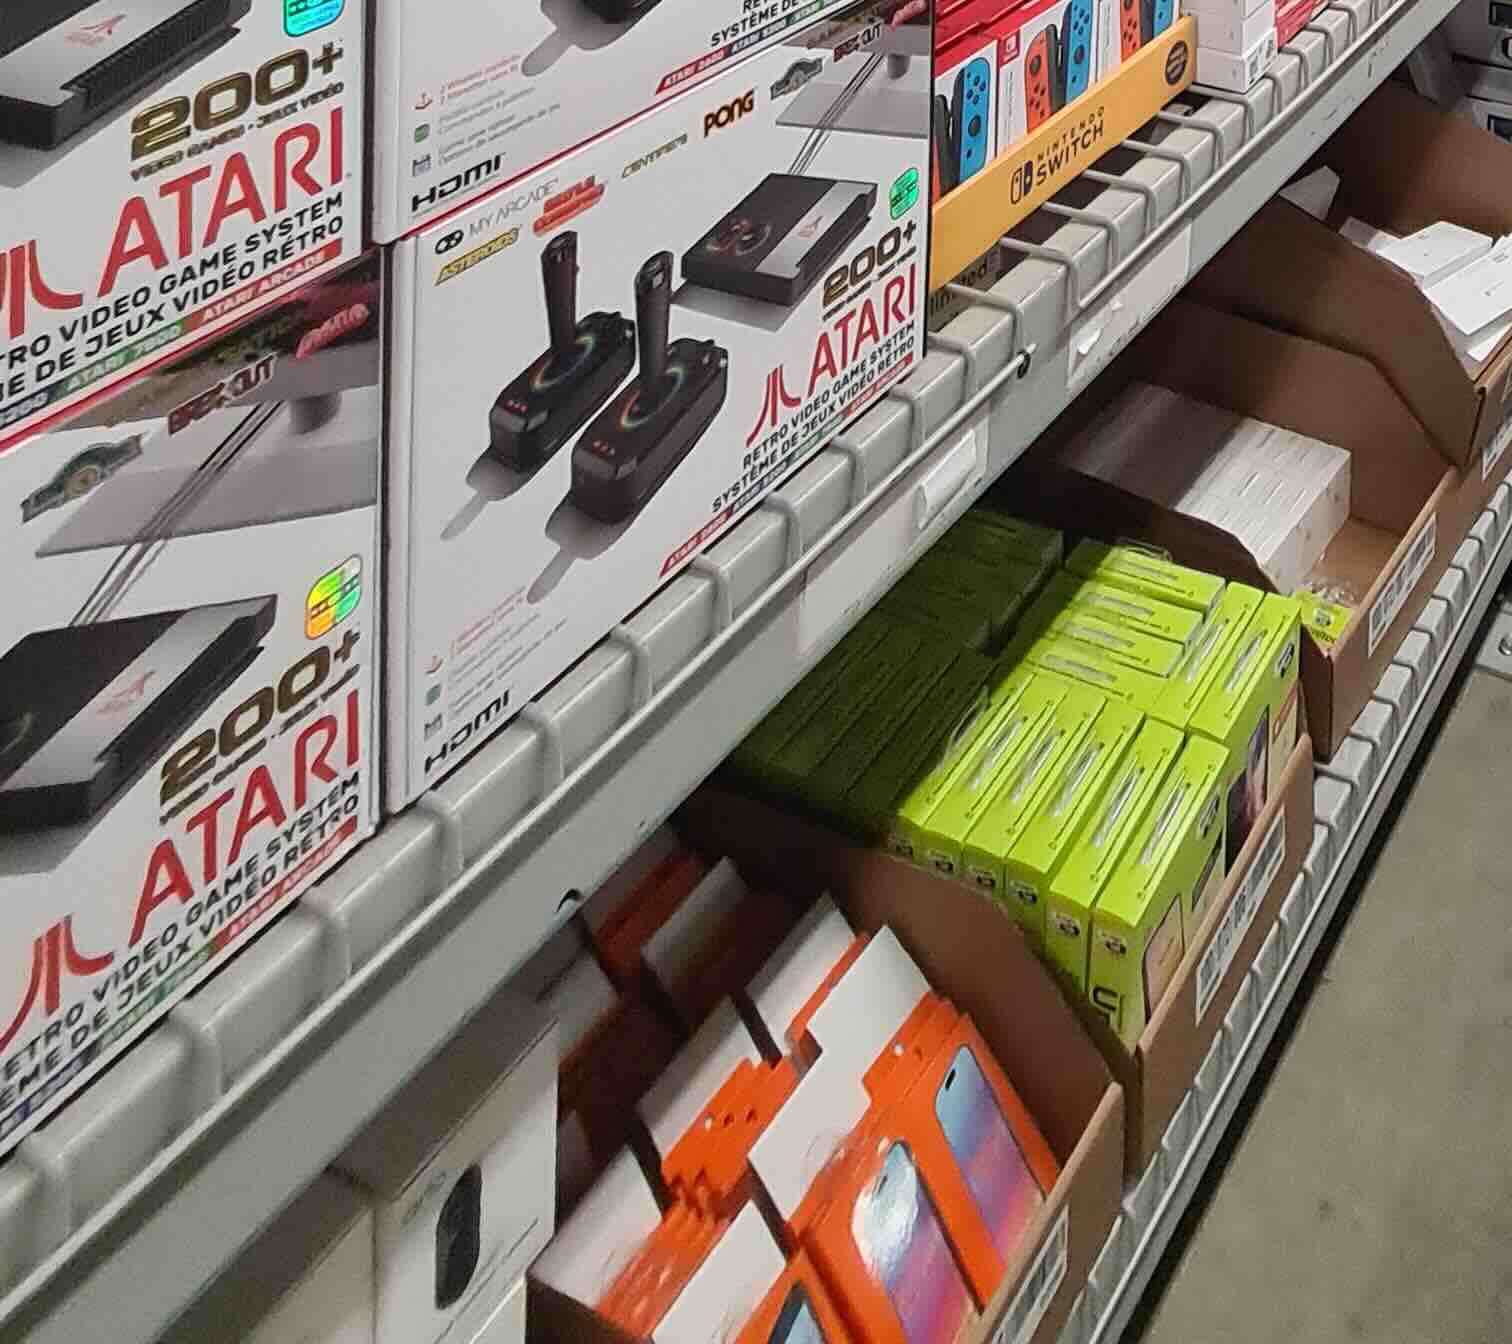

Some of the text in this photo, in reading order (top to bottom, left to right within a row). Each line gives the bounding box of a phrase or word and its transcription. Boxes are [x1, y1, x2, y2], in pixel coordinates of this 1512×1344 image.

[132, 41, 343, 161] 200+
[704, 90, 754, 137] PONG
[1036, 120, 1103, 186] SWITCH
[1038, 106, 1104, 161] NINTENDO
[98, 106, 343, 298] ATARI
[412, 154, 502, 211] HDMI
[470, 215, 493, 238] MY
[36, 349, 76, 383] DE
[87, 303, 166, 356] JEUX
[173, 263, 253, 316] VIDÉO
[263, 216, 343, 266] RÉTRO
[60, 285, 150, 340] VIDEO
[160, 243, 236, 294] GAME
[245, 191, 343, 251] SYSTEM
[823, 219, 917, 307] 200+
[808, 264, 916, 398] ATARI
[744, 321, 915, 470] RETRO VIDEO GAME SYSTEM
[782, 436, 799, 459] DE
[802, 404, 836, 441] JEUX
[160, 629, 360, 806] 200+
[424, 689, 509, 774] HDMI
[129, 689, 359, 946] ATARI
[4, 1003, 85, 1081] ETRO
[93, 922, 179, 1002] VIDEO
[186, 853, 259, 923] GAME
[266, 772, 359, 854] SYSTEM
[71, 1012, 109, 1047] DE
[117, 941, 192, 1011] JEUX
